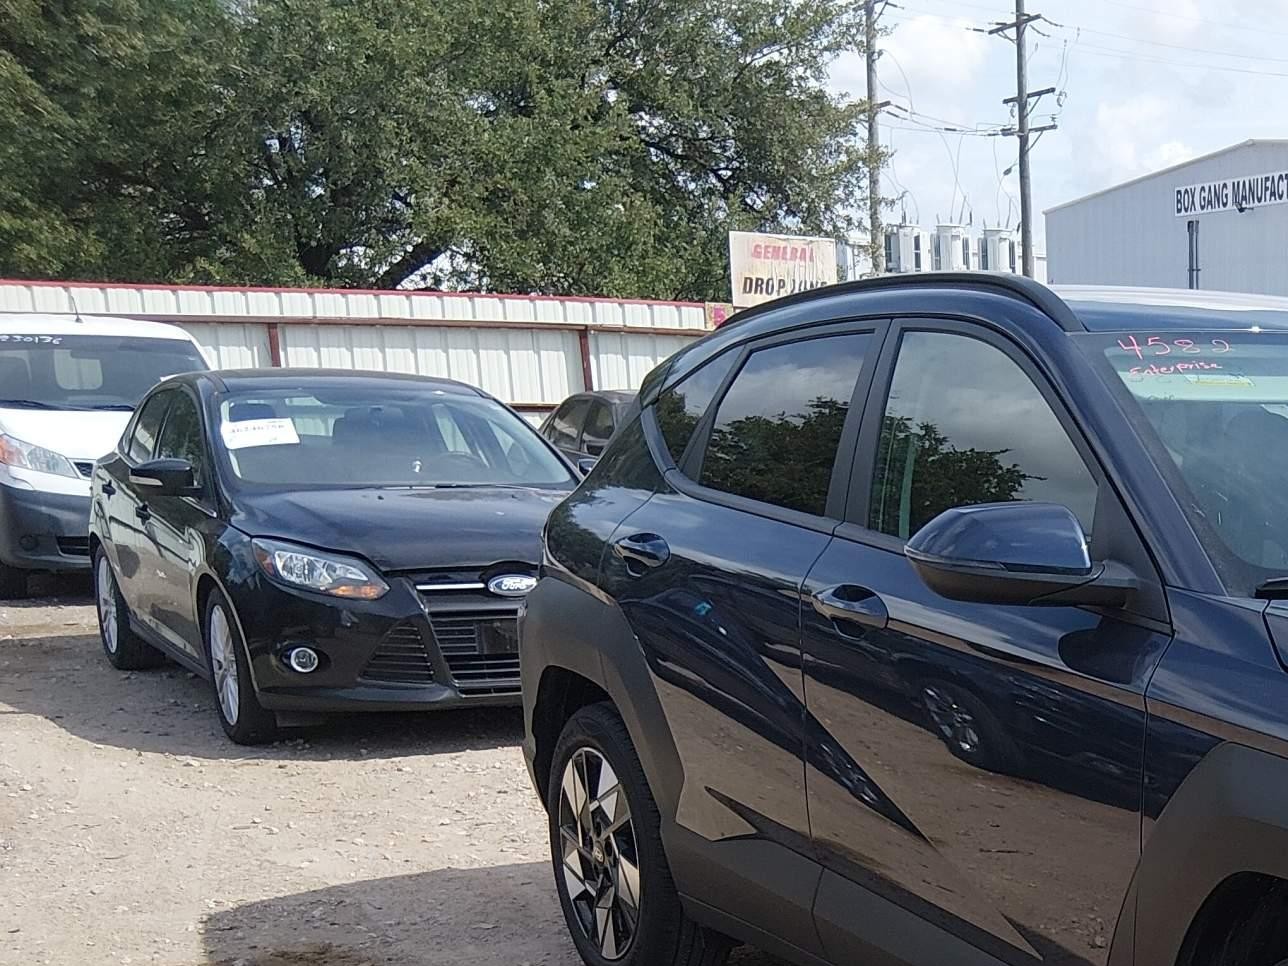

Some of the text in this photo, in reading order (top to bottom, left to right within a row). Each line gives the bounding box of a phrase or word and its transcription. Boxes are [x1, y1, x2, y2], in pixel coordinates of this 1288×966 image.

[1176, 186, 1197, 214] BOX
[1200, 182, 1229, 211] GANG
[742, 276, 786, 297] DROP
